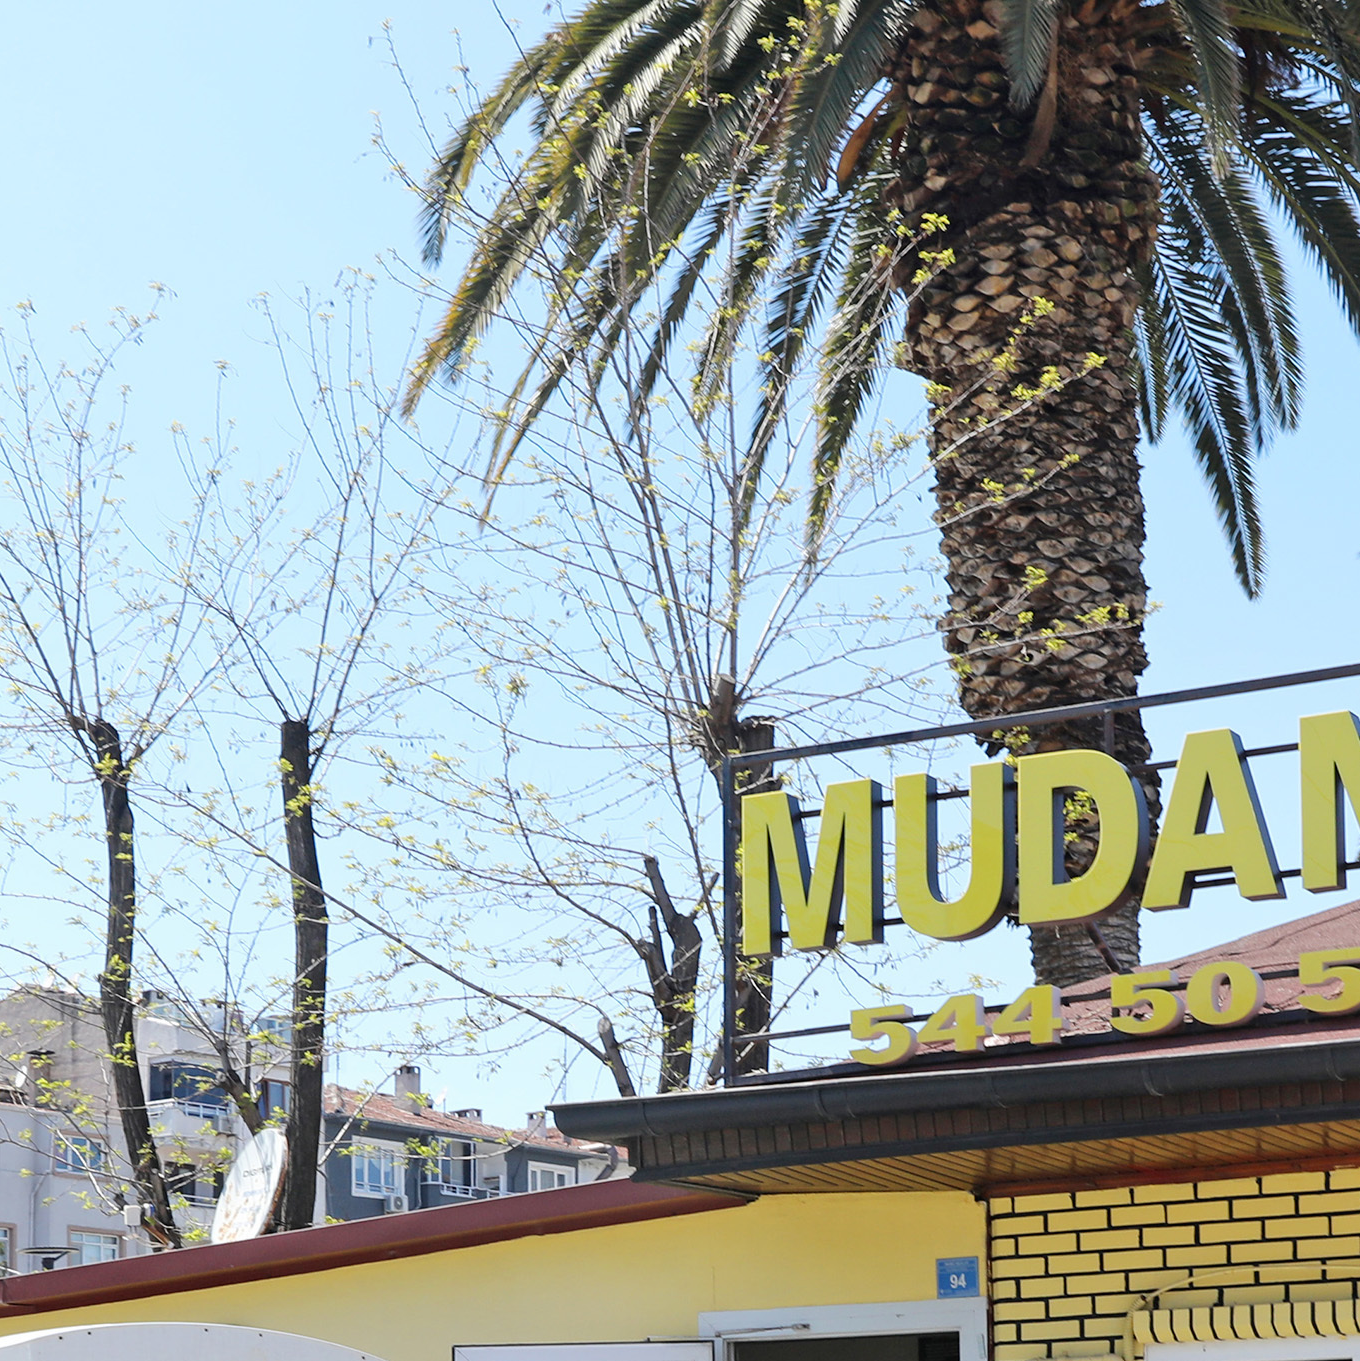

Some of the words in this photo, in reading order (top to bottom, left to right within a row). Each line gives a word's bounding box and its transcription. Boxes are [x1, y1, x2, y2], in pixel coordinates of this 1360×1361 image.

[849, 982, 1070, 1069] 544
[1108, 957, 1265, 1038] 50
[950, 1273, 967, 1289] 94
